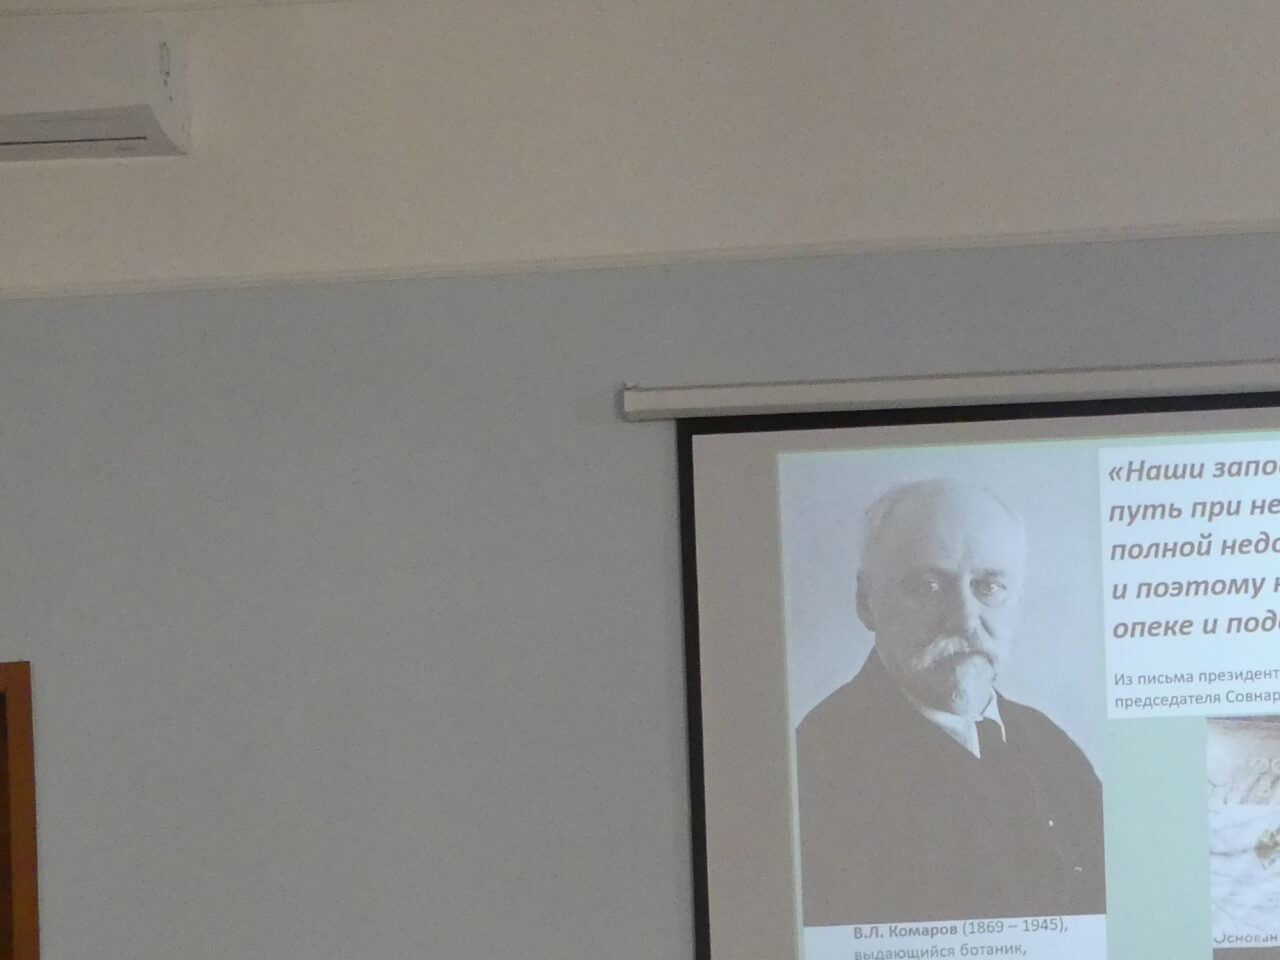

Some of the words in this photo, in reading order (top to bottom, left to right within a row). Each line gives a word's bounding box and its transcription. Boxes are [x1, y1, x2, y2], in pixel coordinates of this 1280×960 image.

[1108, 460, 1205, 482] «Наши
[1109, 501, 1183, 526] путь
[1191, 499, 1242, 522] при
[1110, 532, 1213, 561] полной
[1112, 582, 1127, 600] и
[1136, 576, 1266, 600] поэтому
[1113, 618, 1193, 639] опеке
[1202, 617, 1218, 635] и
[1114, 673, 1133, 687] Из
[1138, 671, 1194, 685] письма
[1115, 692, 1221, 709] председателя
[854, 925, 884, 940] В.Л.
[888, 923, 959, 941] Комаров
[962, 919, 1005, 937] (1869
[1022, 917, 1069, 934] 1945),
[960, 943, 1027, 957] ботаник,
